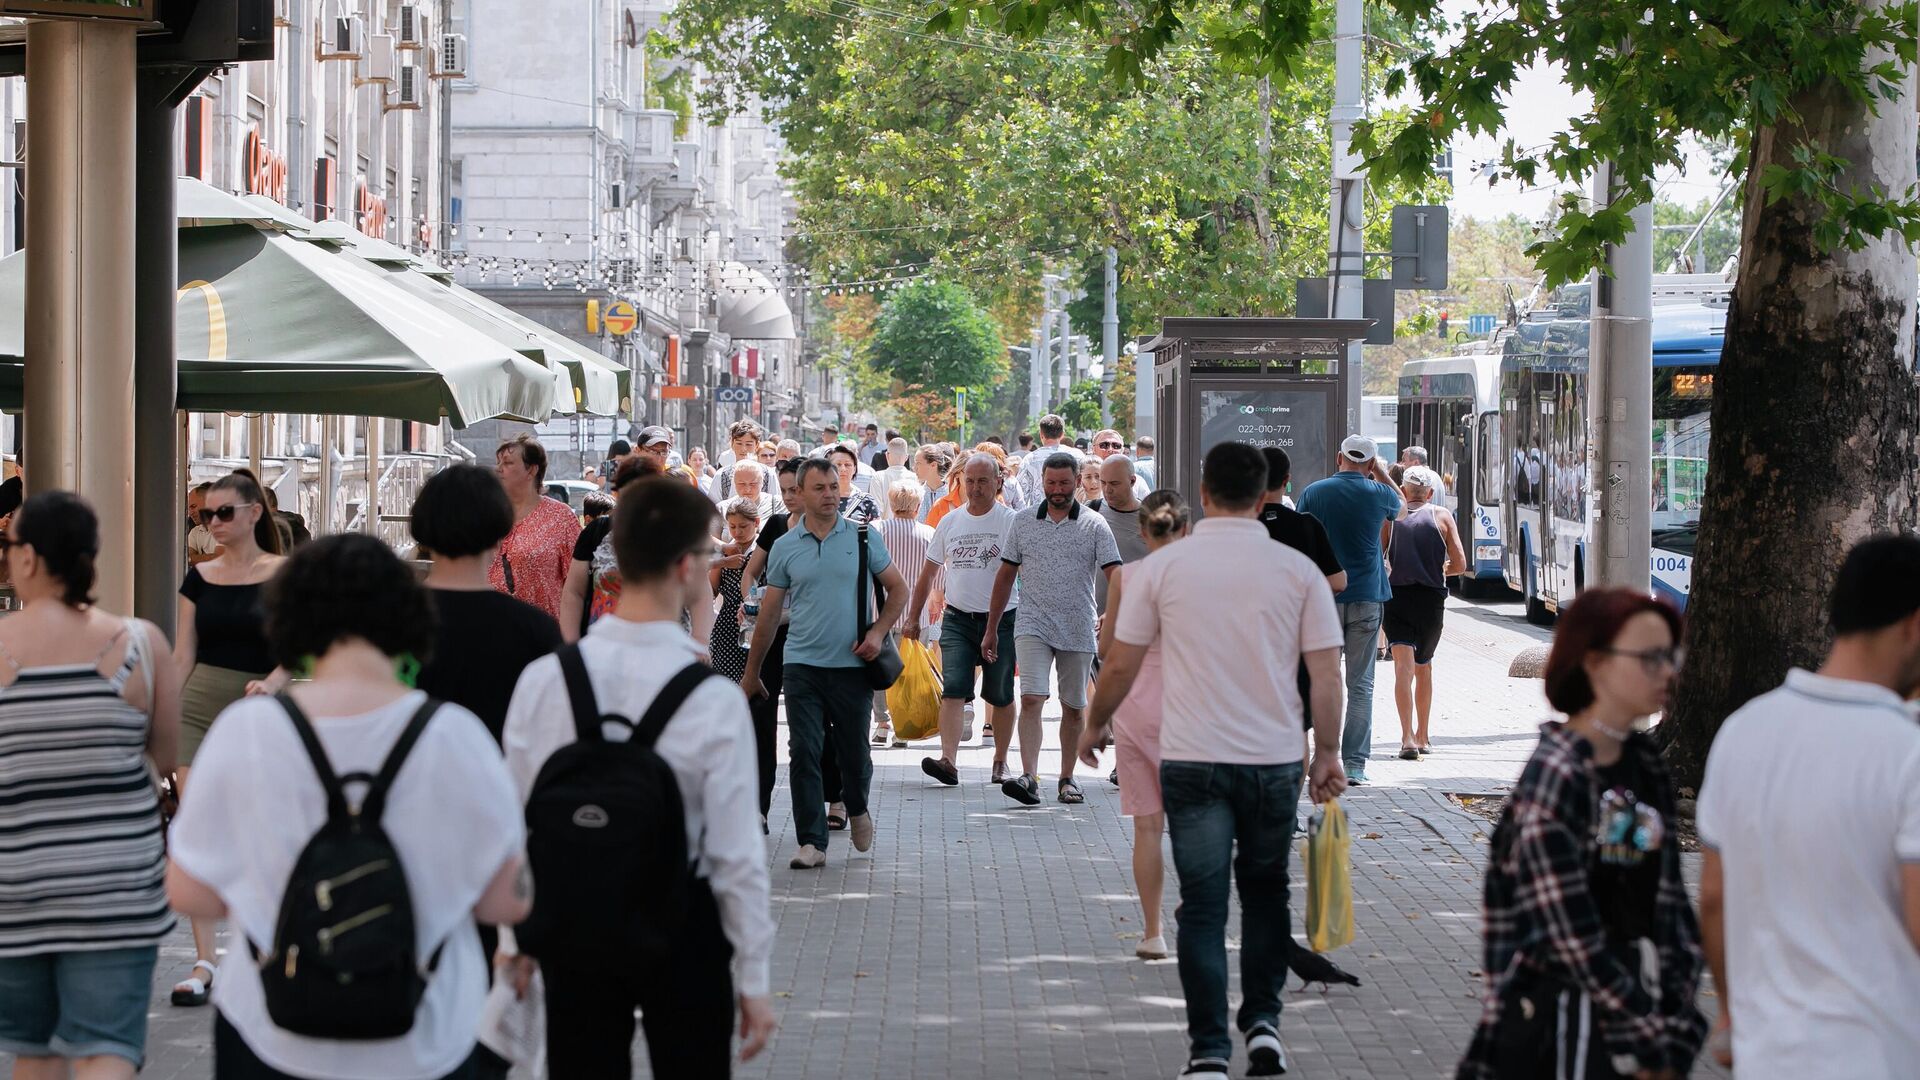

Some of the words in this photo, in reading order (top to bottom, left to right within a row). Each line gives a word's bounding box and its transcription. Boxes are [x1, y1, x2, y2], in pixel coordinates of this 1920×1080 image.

[1676, 374, 1695, 389] 22
[1238, 425, 1291, 433] 022-010-777
[1278, 438, 1294, 446] 26B
[952, 546, 979, 558] 1973
[1651, 557, 1687, 571] 1004
